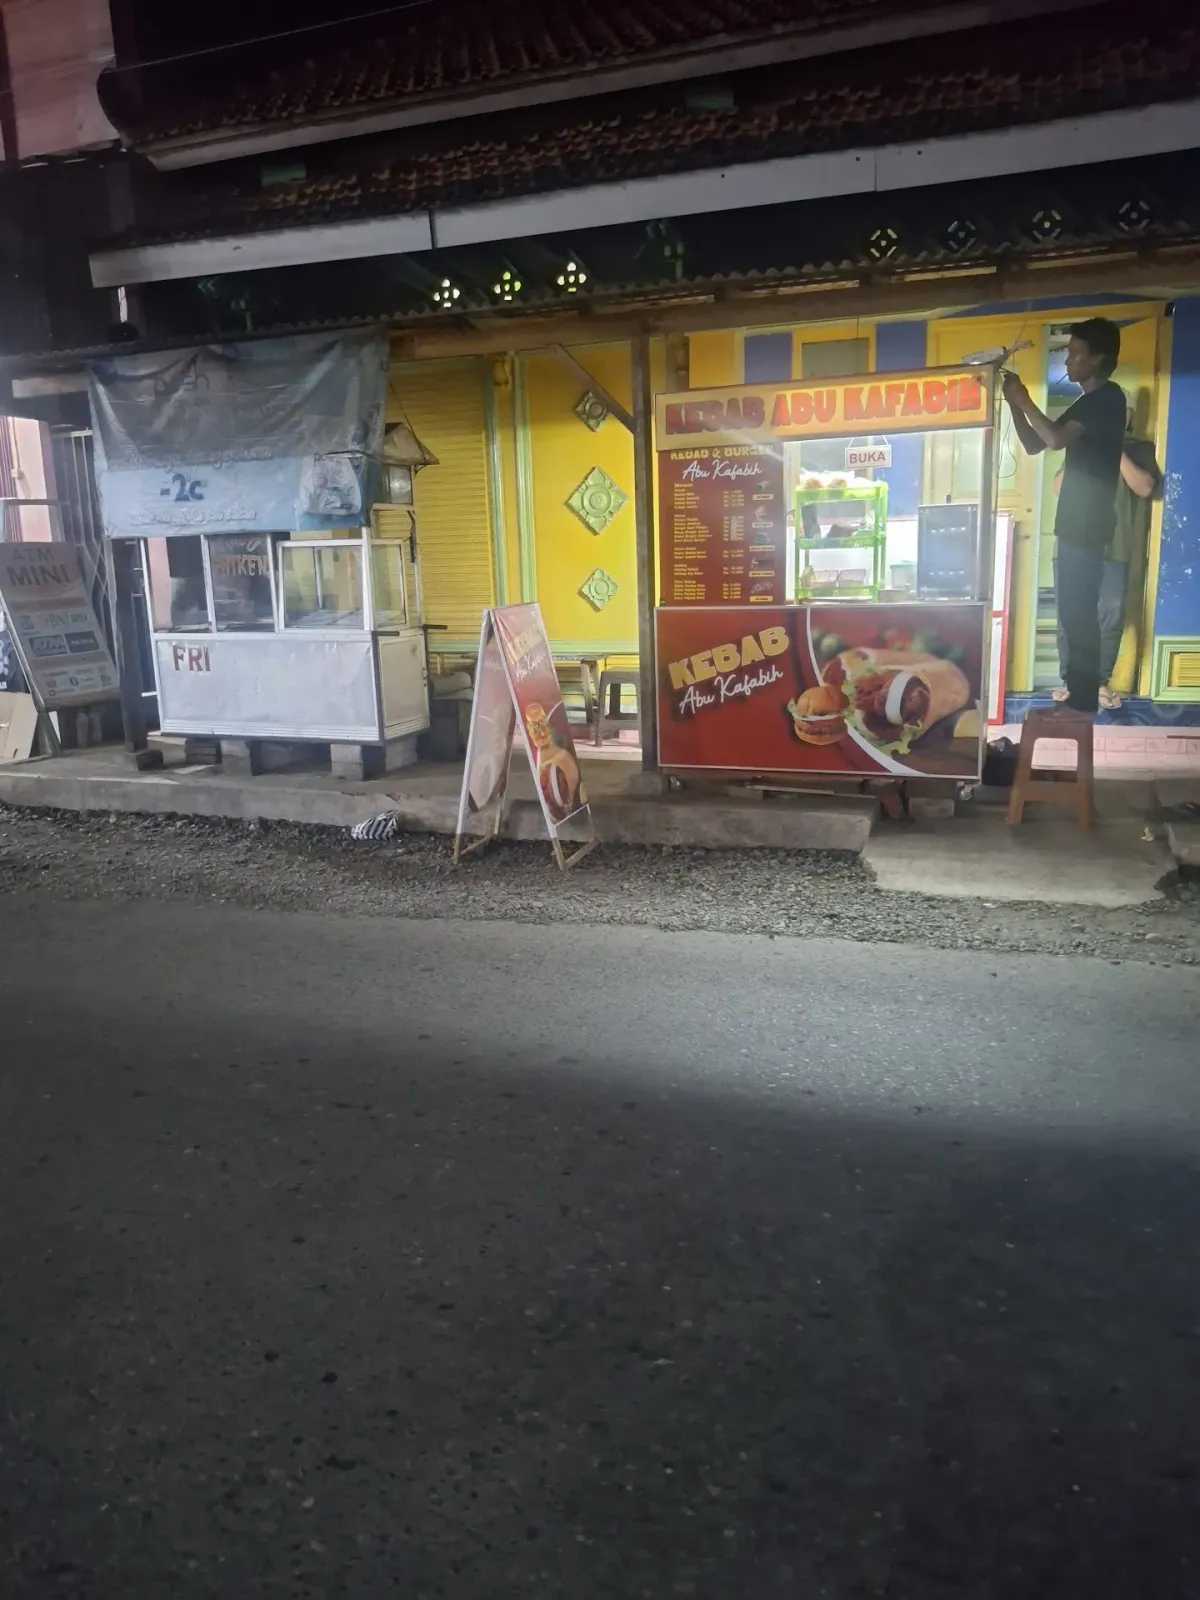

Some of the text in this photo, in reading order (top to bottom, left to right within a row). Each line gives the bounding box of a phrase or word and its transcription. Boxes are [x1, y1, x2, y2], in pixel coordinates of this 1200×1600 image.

[665, 396, 765, 435] KEBAB
[771, 389, 836, 427] ABU
[682, 459, 762, 482] Abu Kafabih
[849, 451, 886, 465] BUKA
[6, 564, 70, 587] MINI
[172, 644, 211, 672] FRI
[668, 626, 790, 690] KEBAB
[679, 665, 784, 715] Abu Kafabih
